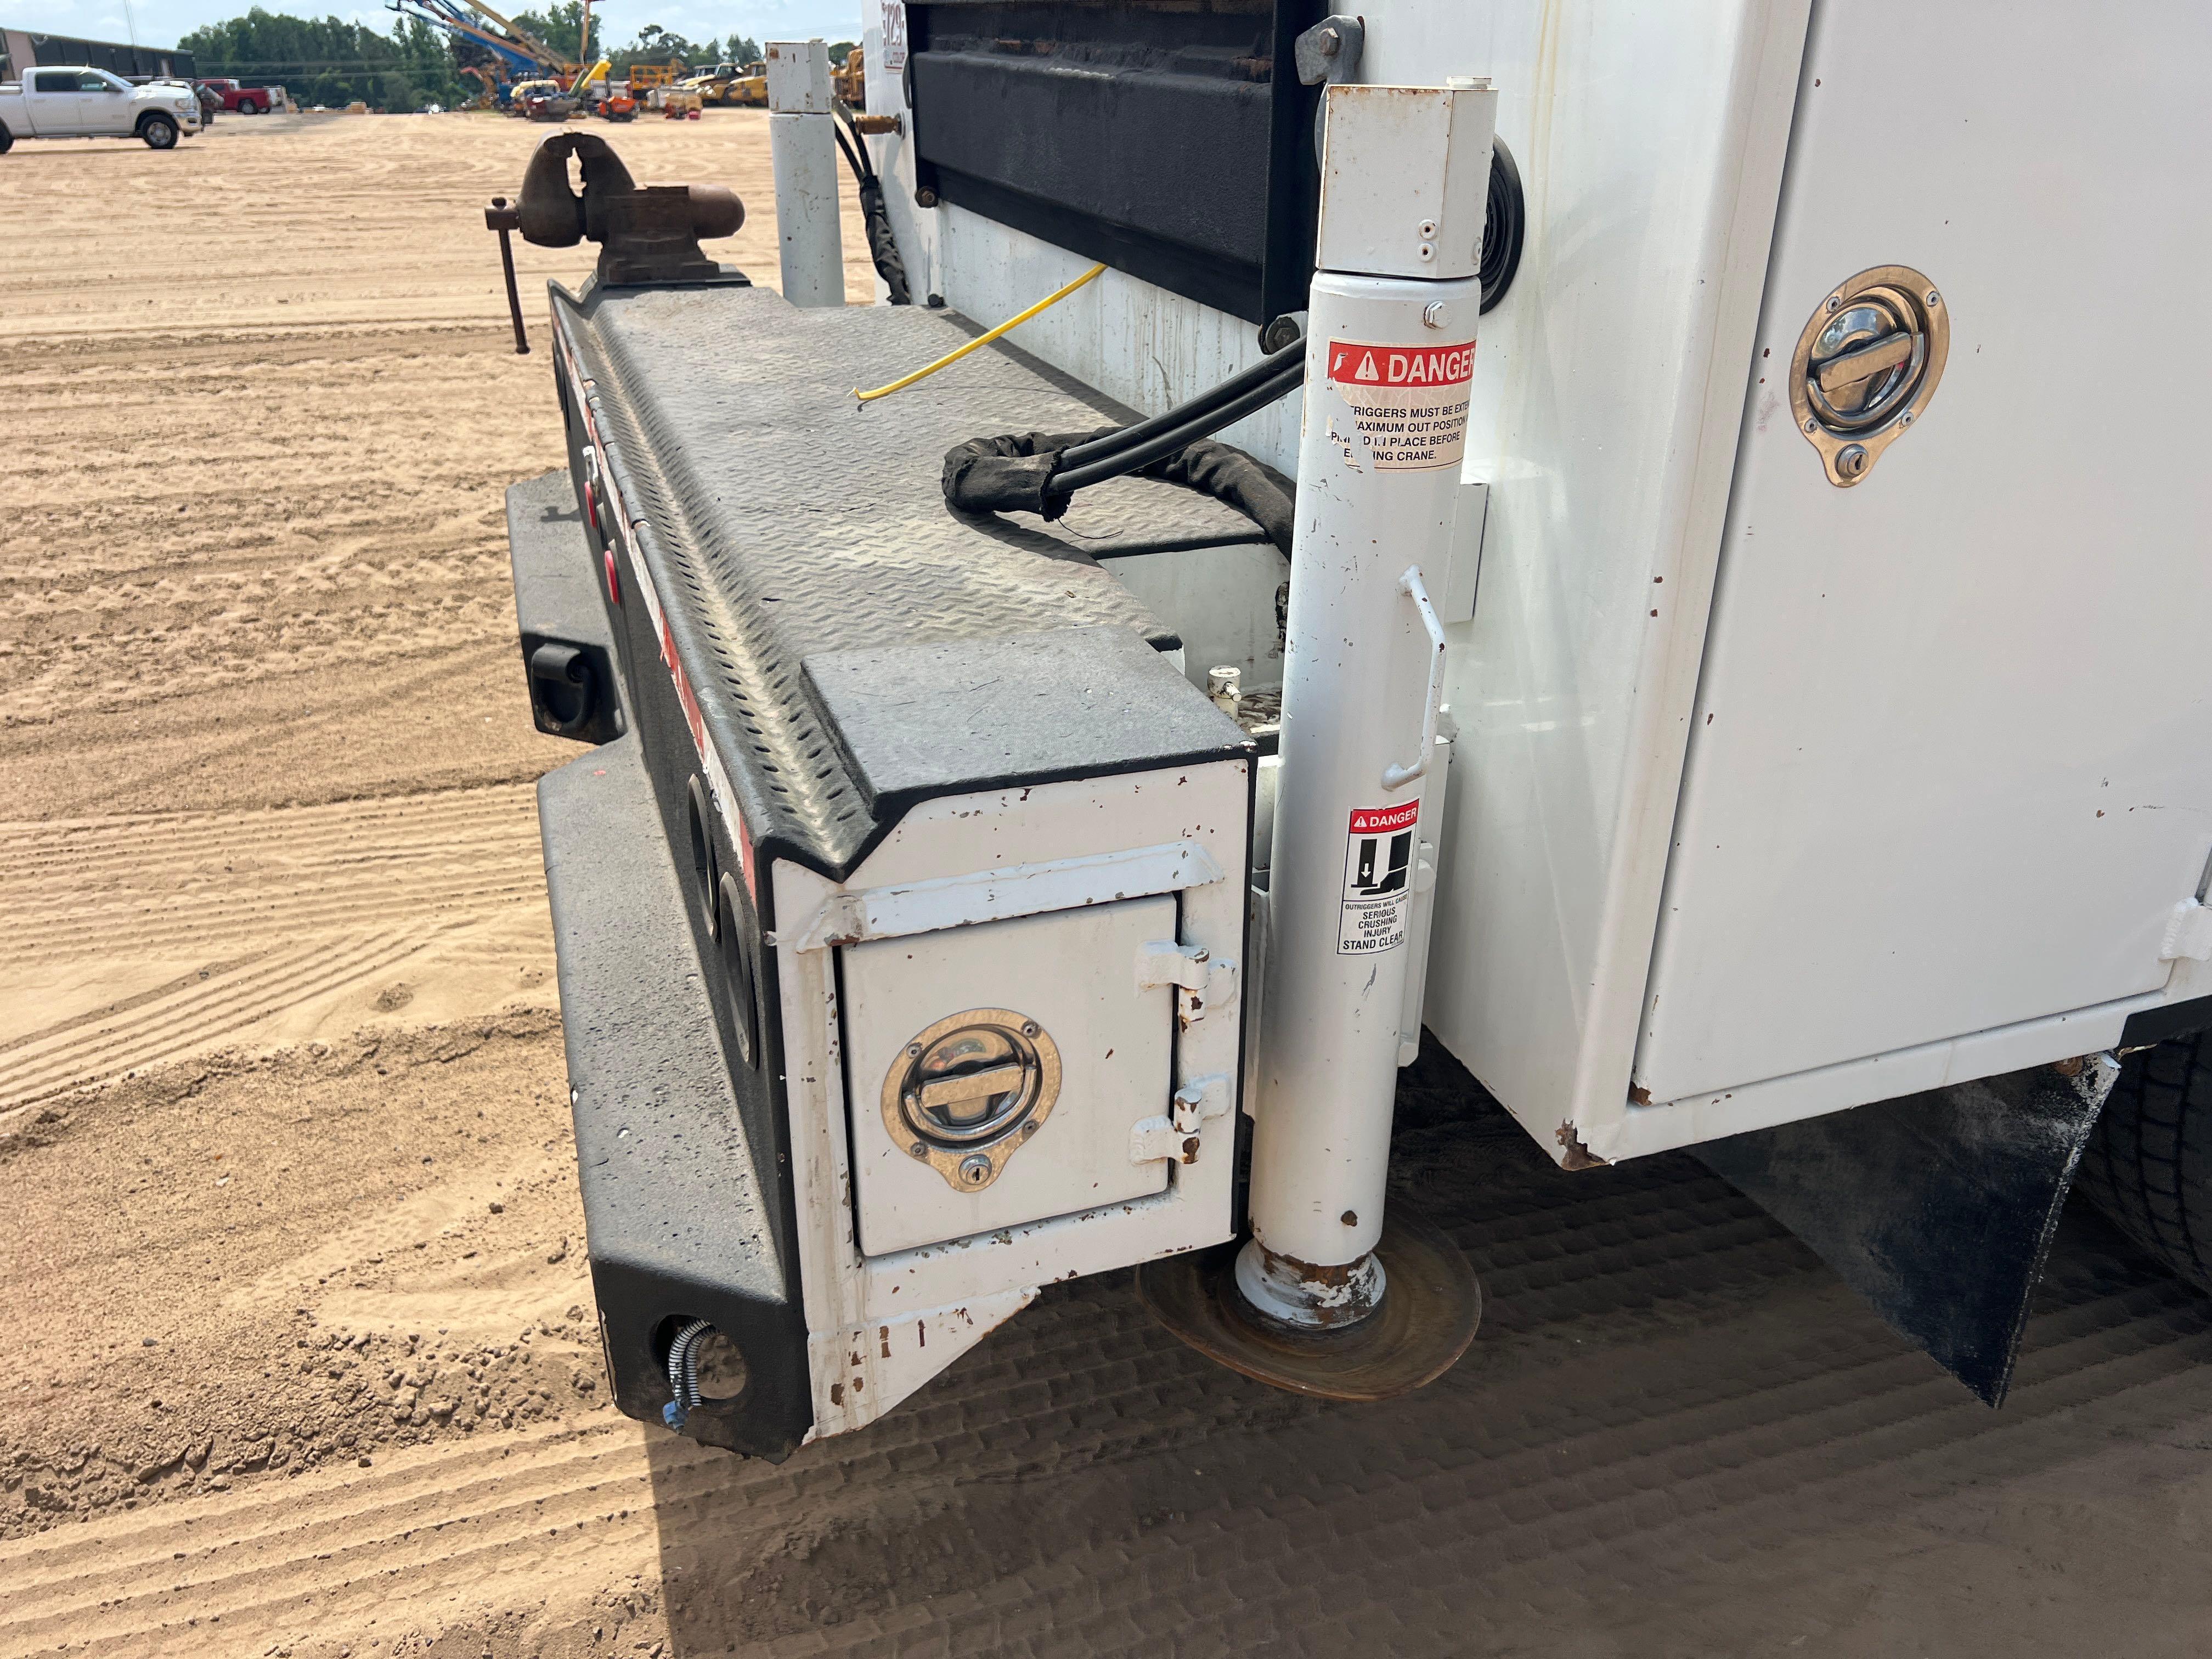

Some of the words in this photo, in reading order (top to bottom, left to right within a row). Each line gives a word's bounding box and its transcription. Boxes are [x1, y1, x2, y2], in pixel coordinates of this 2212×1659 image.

[1388, 347, 1475, 382] DANGER
[1350, 405, 1407, 418] RIGGERS
[1410, 407, 1440, 417] MUST
[1442, 405, 1453, 415] BE
[1356, 421, 1404, 432] AXIMUM
[1408, 422, 1431, 432] OUT
[1433, 415, 1466, 431] POSITION
[1390, 437, 1426, 447] PLACE
[1430, 431, 1460, 445] BEFORE
[1397, 450, 1437, 461] CRANE.
[1369, 807, 1417, 827] DANGER
[1363, 906, 1396, 919] SERIOUS
[1358, 915, 1398, 929] CRUSHING
[1364, 926, 1392, 938] INJURY
[1342, 939, 1376, 950] STAND
[1379, 930, 1403, 947] CLEAR
